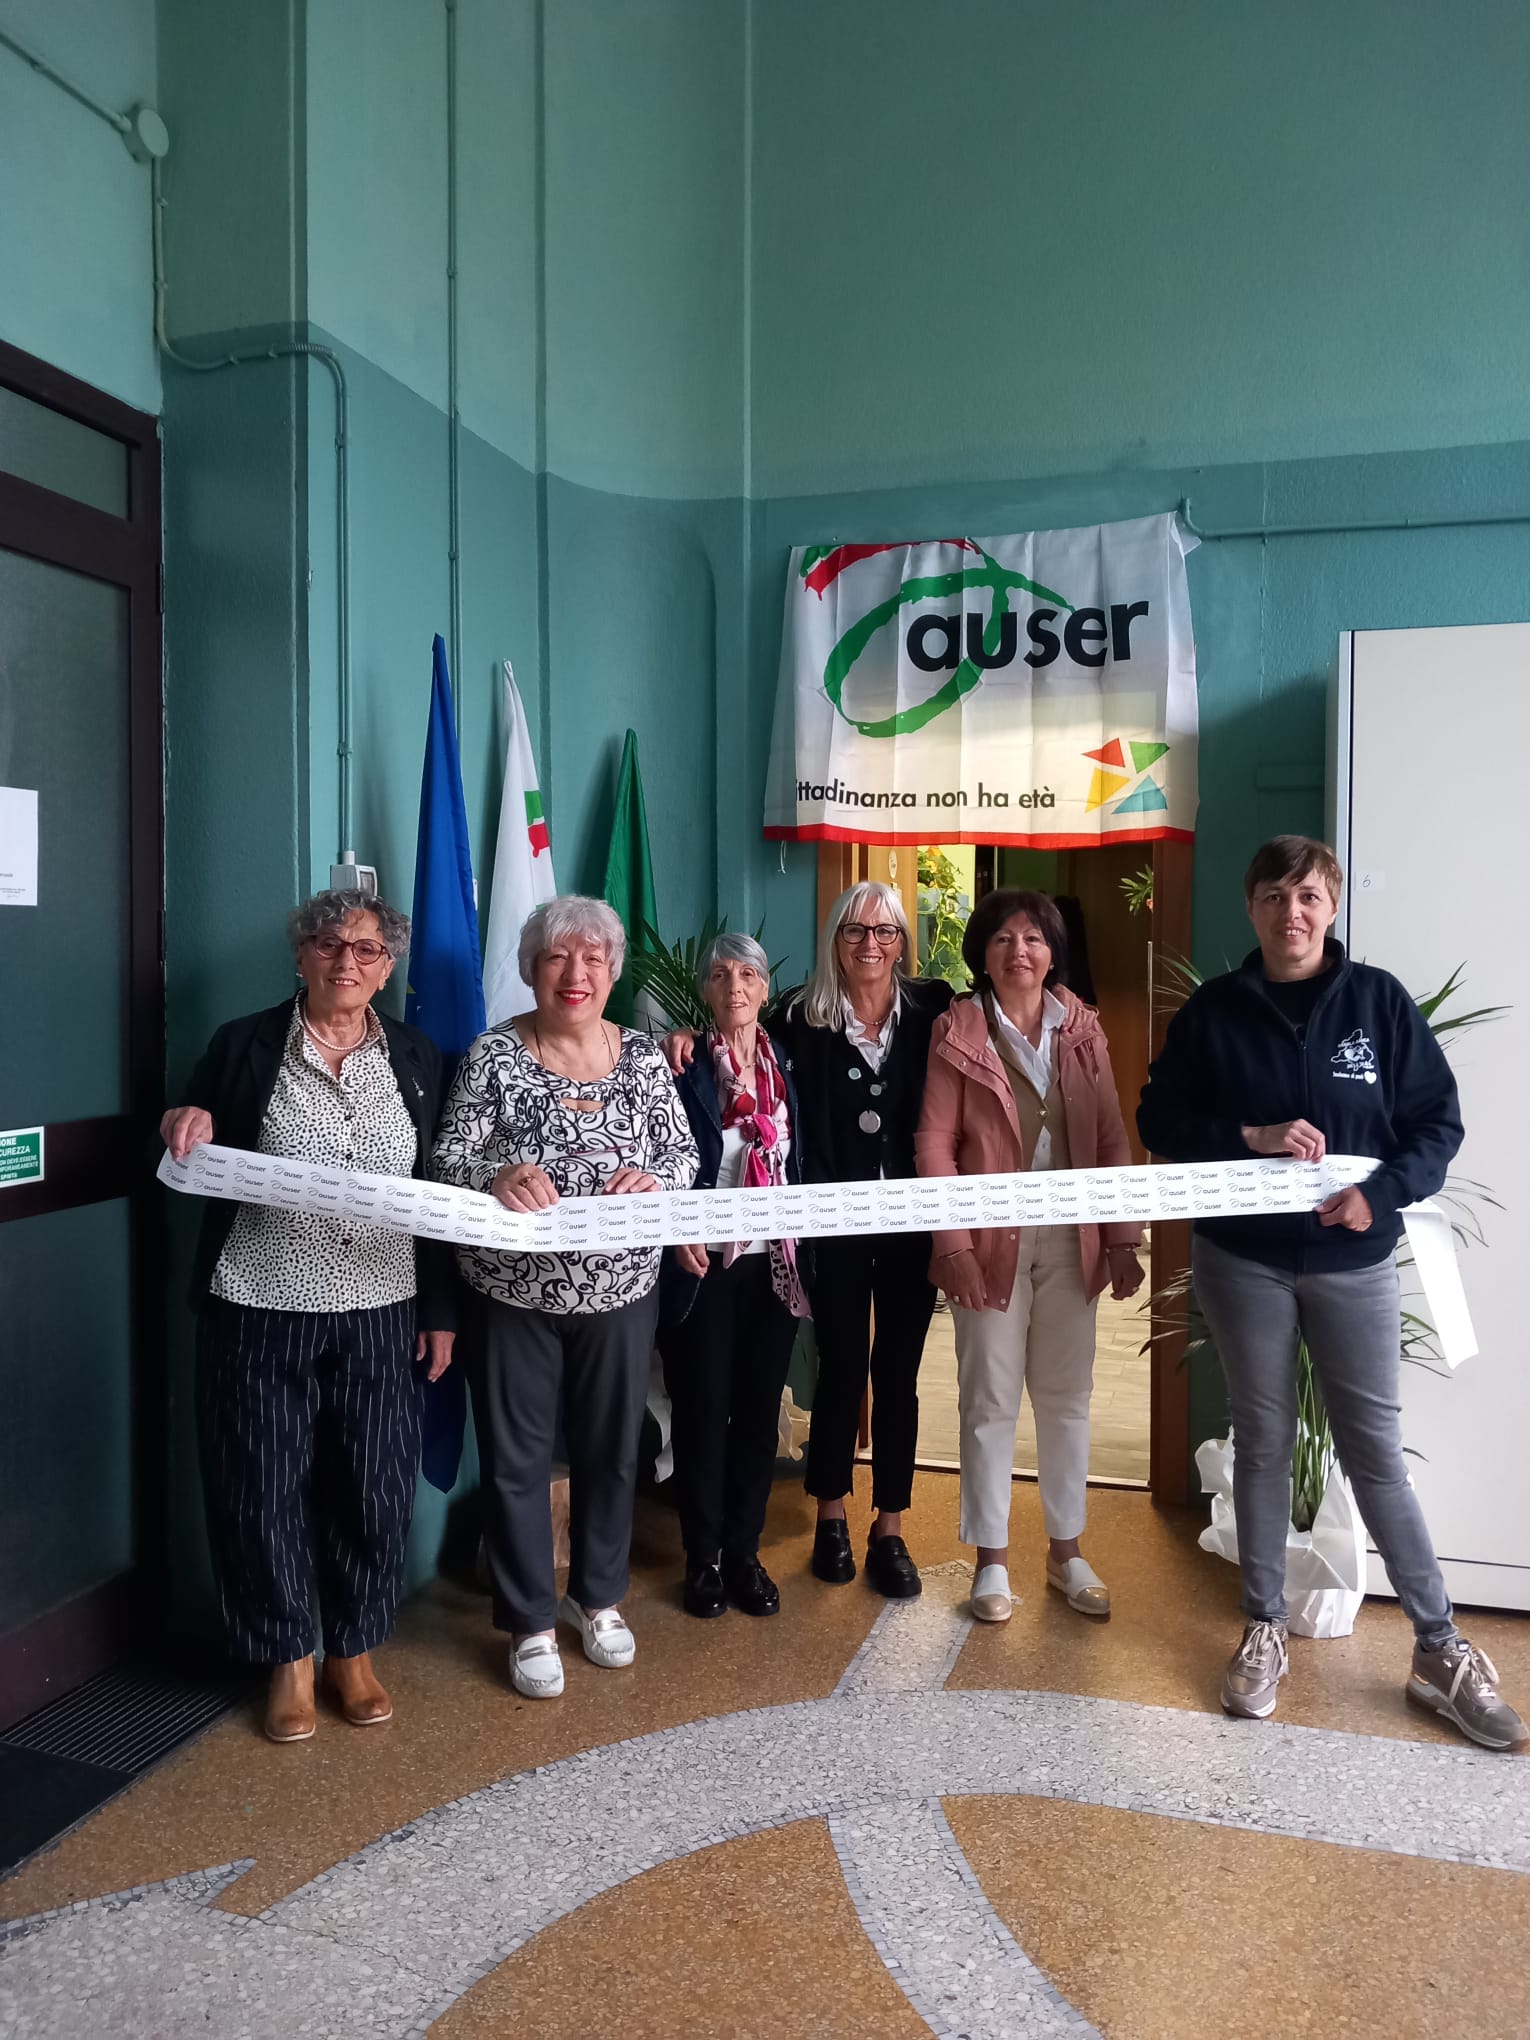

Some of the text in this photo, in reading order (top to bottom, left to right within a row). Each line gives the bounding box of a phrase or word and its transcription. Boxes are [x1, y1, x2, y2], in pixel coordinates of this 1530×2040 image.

[906, 600, 1149, 672] auser
[926, 789, 968, 808] non
[978, 782, 1009, 808] ha
[1018, 785, 1056, 809] età
